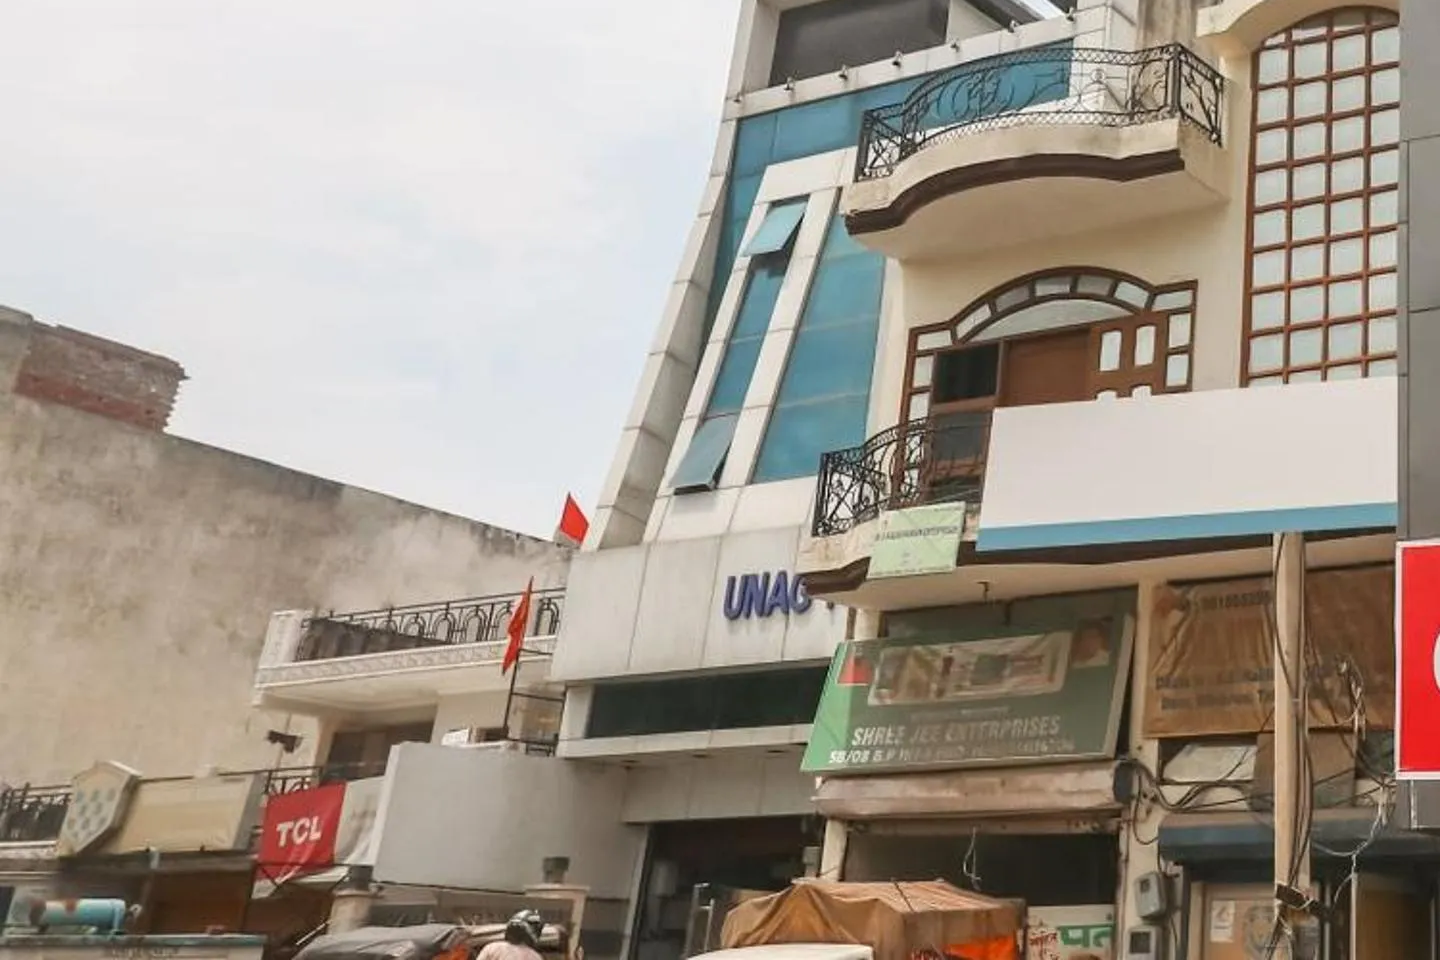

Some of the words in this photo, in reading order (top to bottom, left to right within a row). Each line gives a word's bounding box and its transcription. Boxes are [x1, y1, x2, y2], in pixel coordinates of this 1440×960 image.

[851, 724, 904, 747] SHREE
[945, 714, 1061, 741] ENTERPRISES
[276, 815, 322, 848] TCL
